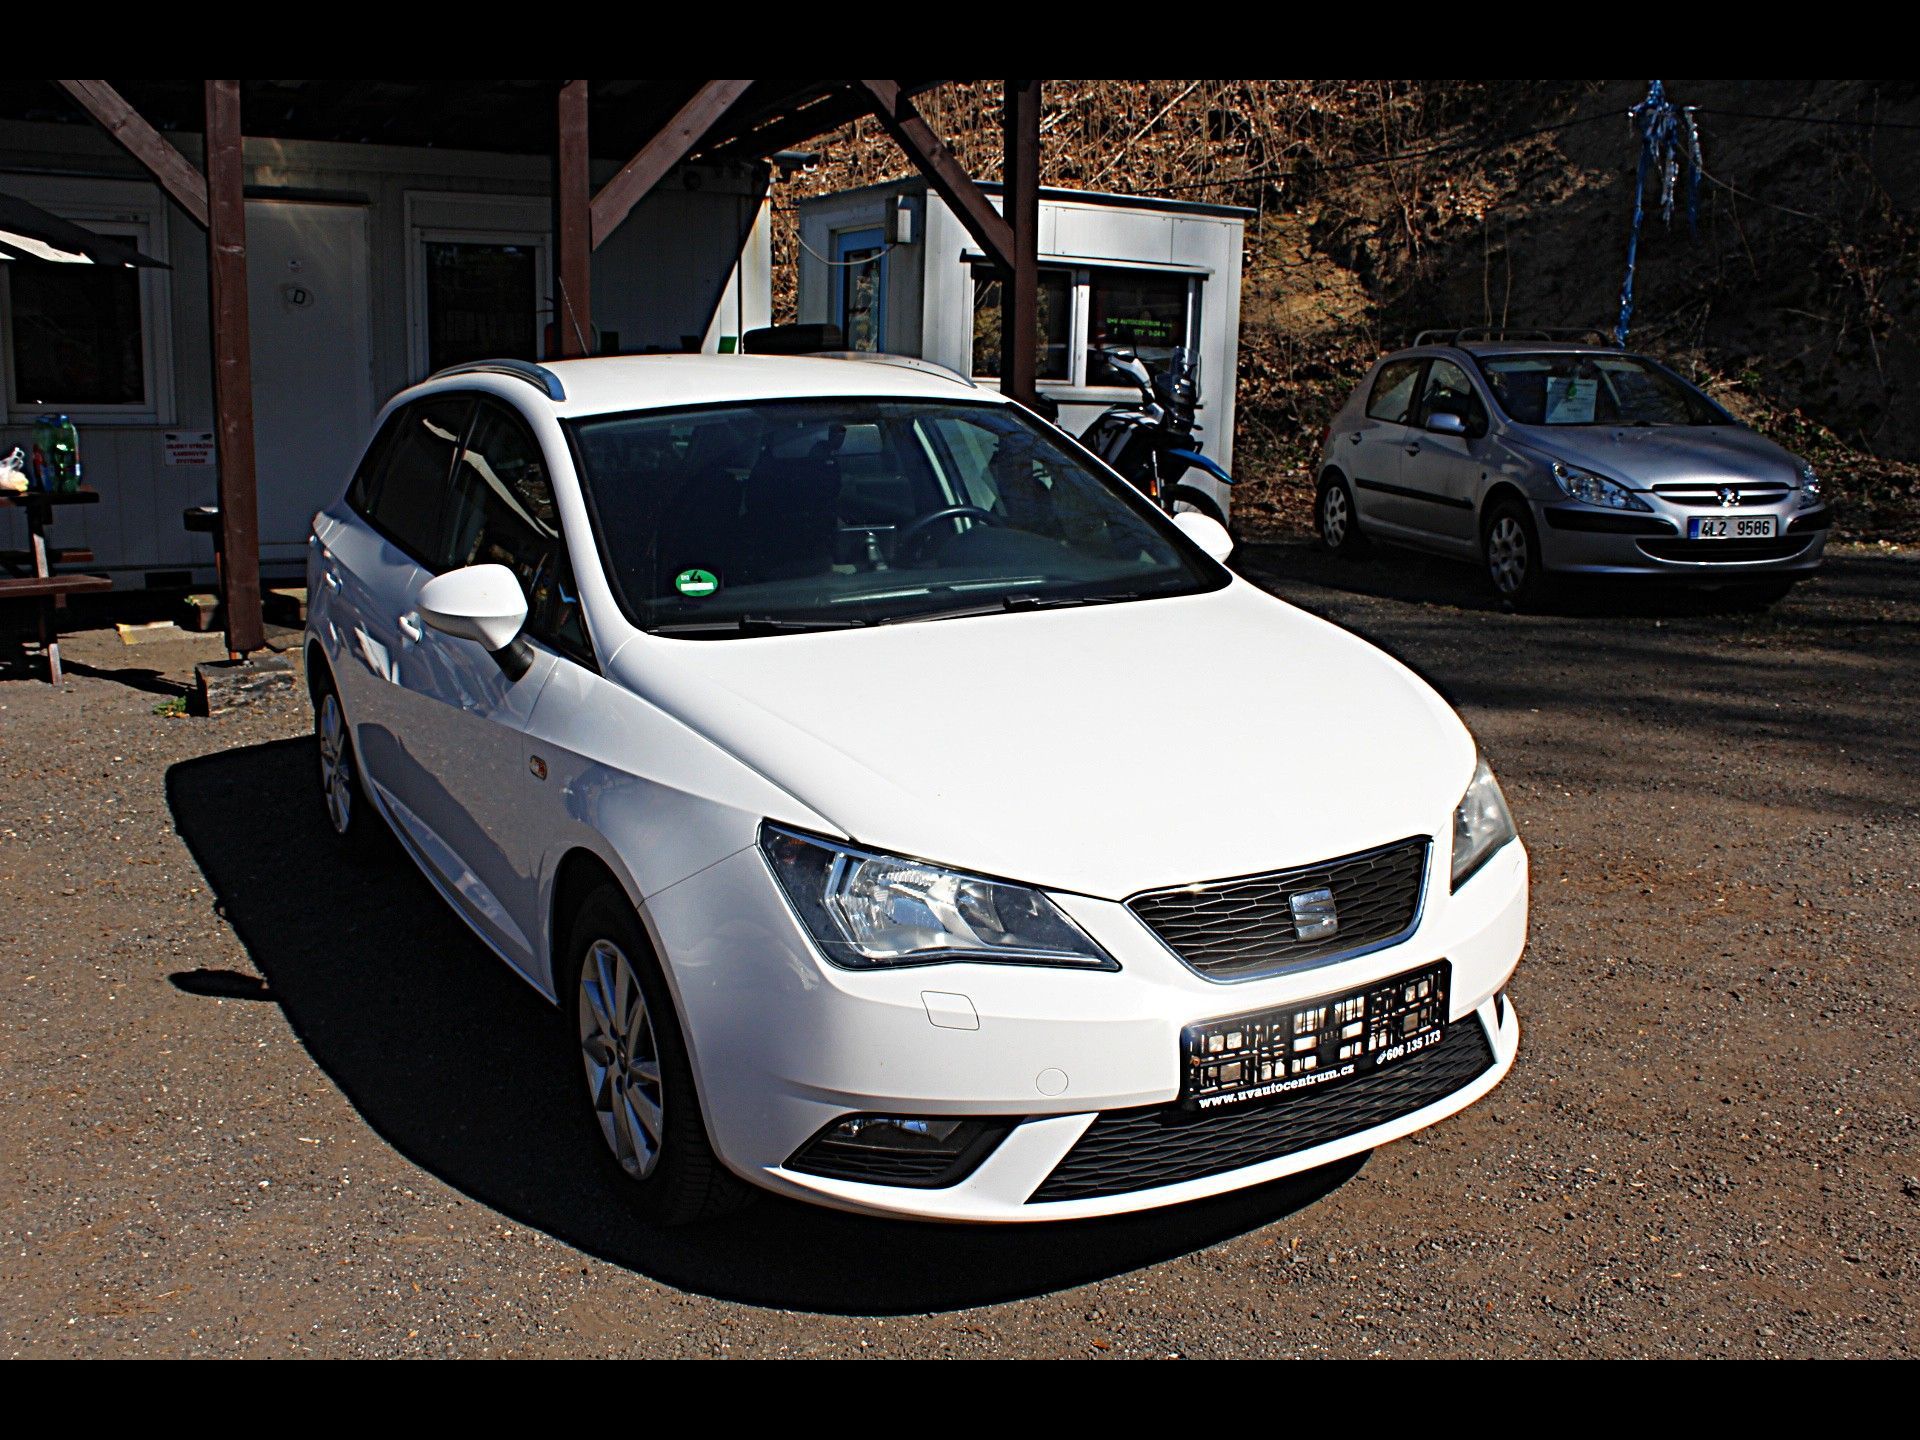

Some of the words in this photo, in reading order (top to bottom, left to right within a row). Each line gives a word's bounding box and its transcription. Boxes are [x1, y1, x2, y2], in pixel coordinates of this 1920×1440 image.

[294, 289, 305, 304] D
[1701, 521, 1727, 537] 4L2
[1737, 520, 1770, 536] 9586
[690, 571, 702, 583] 4
[1199, 1063, 1355, 1109] www.uvautocentrum.cz
[1386, 1045, 1404, 1061] 606
[1406, 1038, 1423, 1056] 135
[1424, 1029, 1441, 1048] 173
